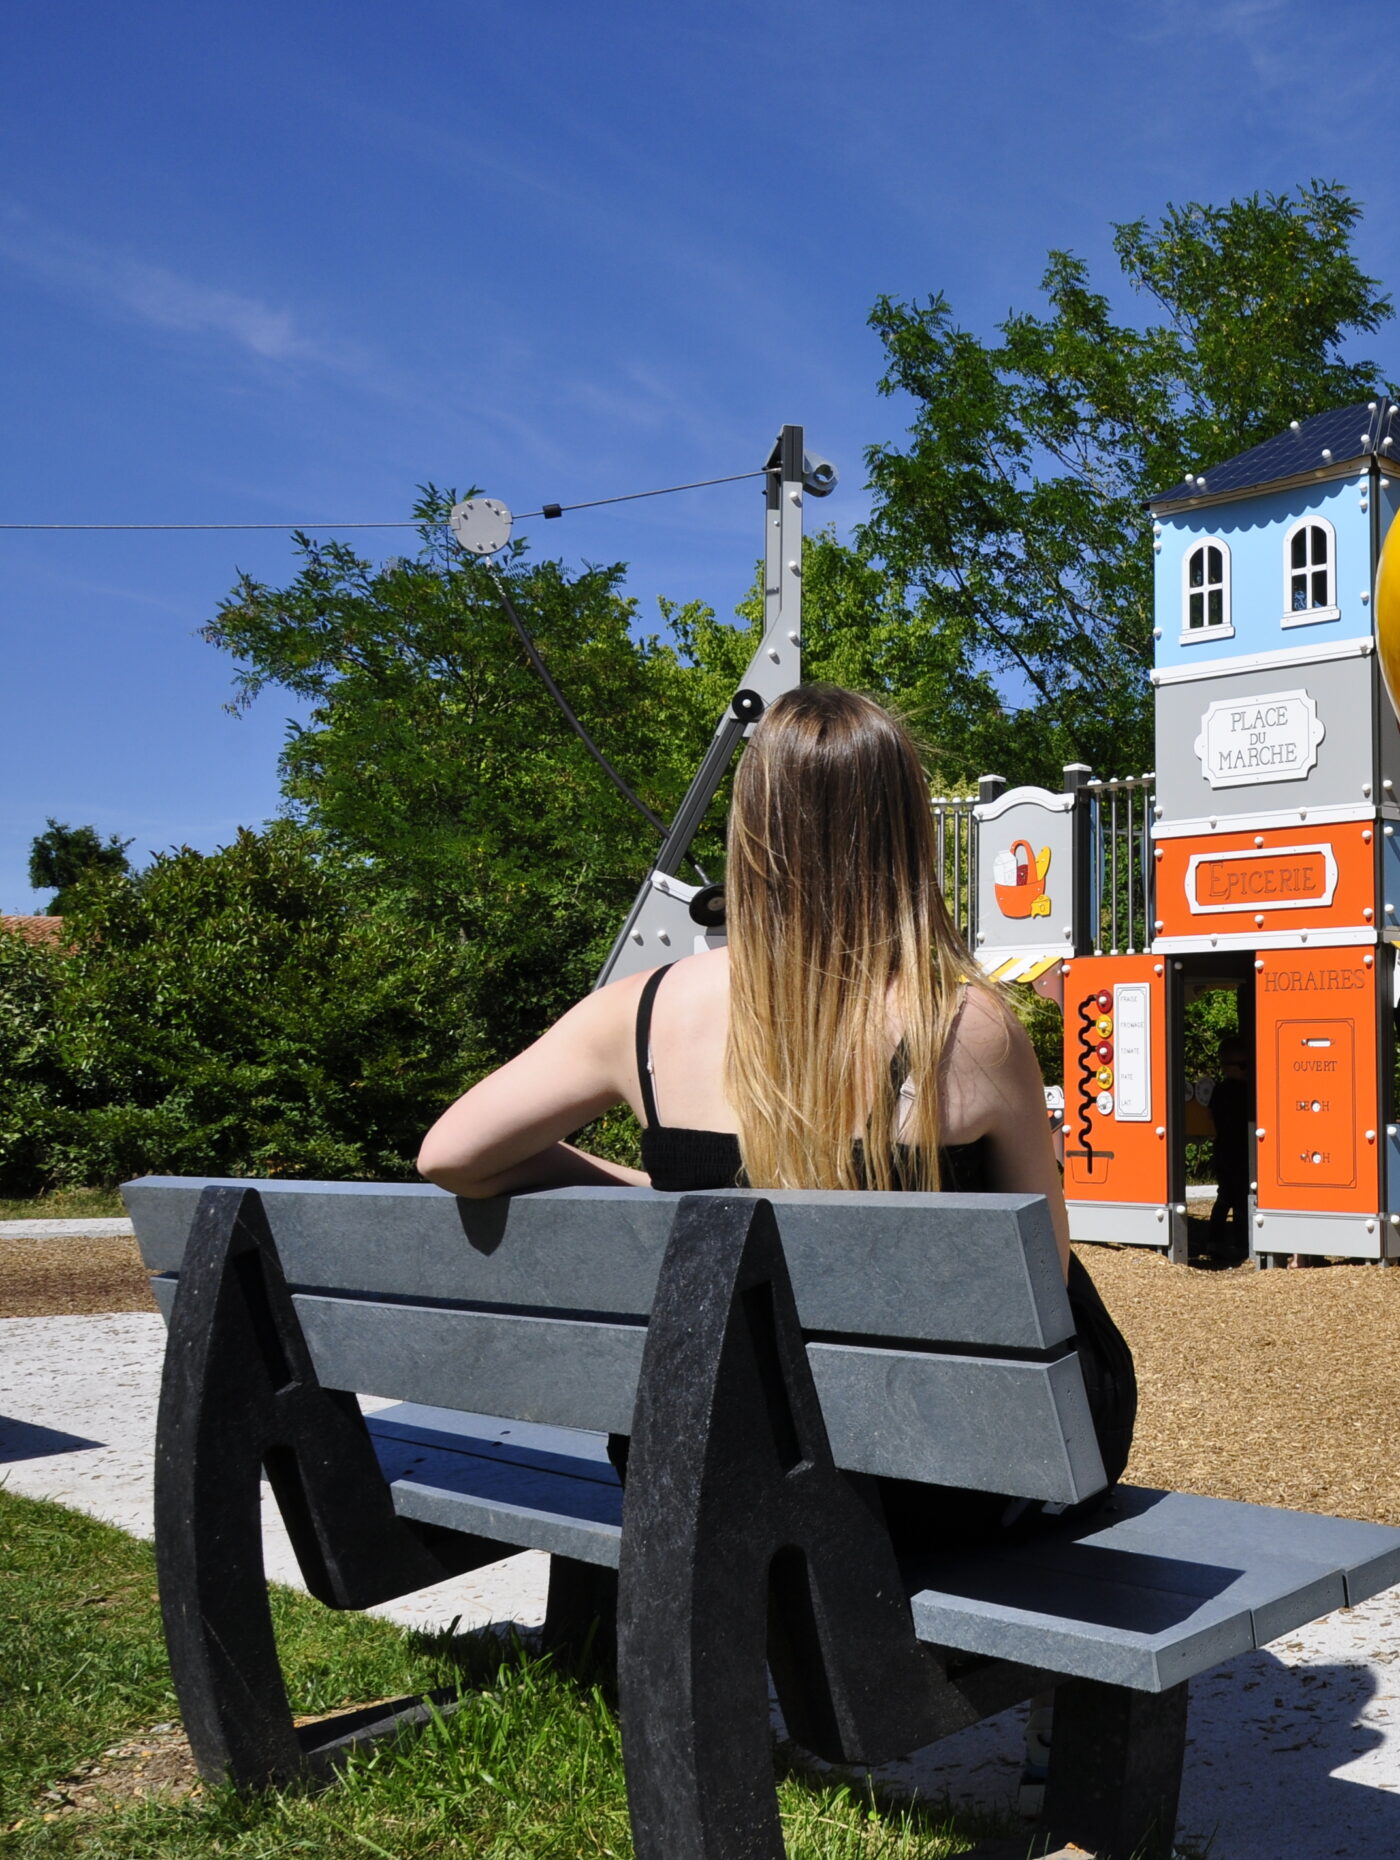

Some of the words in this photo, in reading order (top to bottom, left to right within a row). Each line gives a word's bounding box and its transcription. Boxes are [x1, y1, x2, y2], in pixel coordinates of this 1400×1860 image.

[1230, 706, 1288, 732] PLACE
[1249, 732, 1266, 746] DU
[1218, 743, 1297, 770] MARCHE
[1208, 861, 1317, 900] EPICERIE
[1263, 969, 1365, 992] HORAIRES
[1120, 1047, 1139, 1055] TOMATE
[1293, 1060, 1338, 1072] OUVERT
